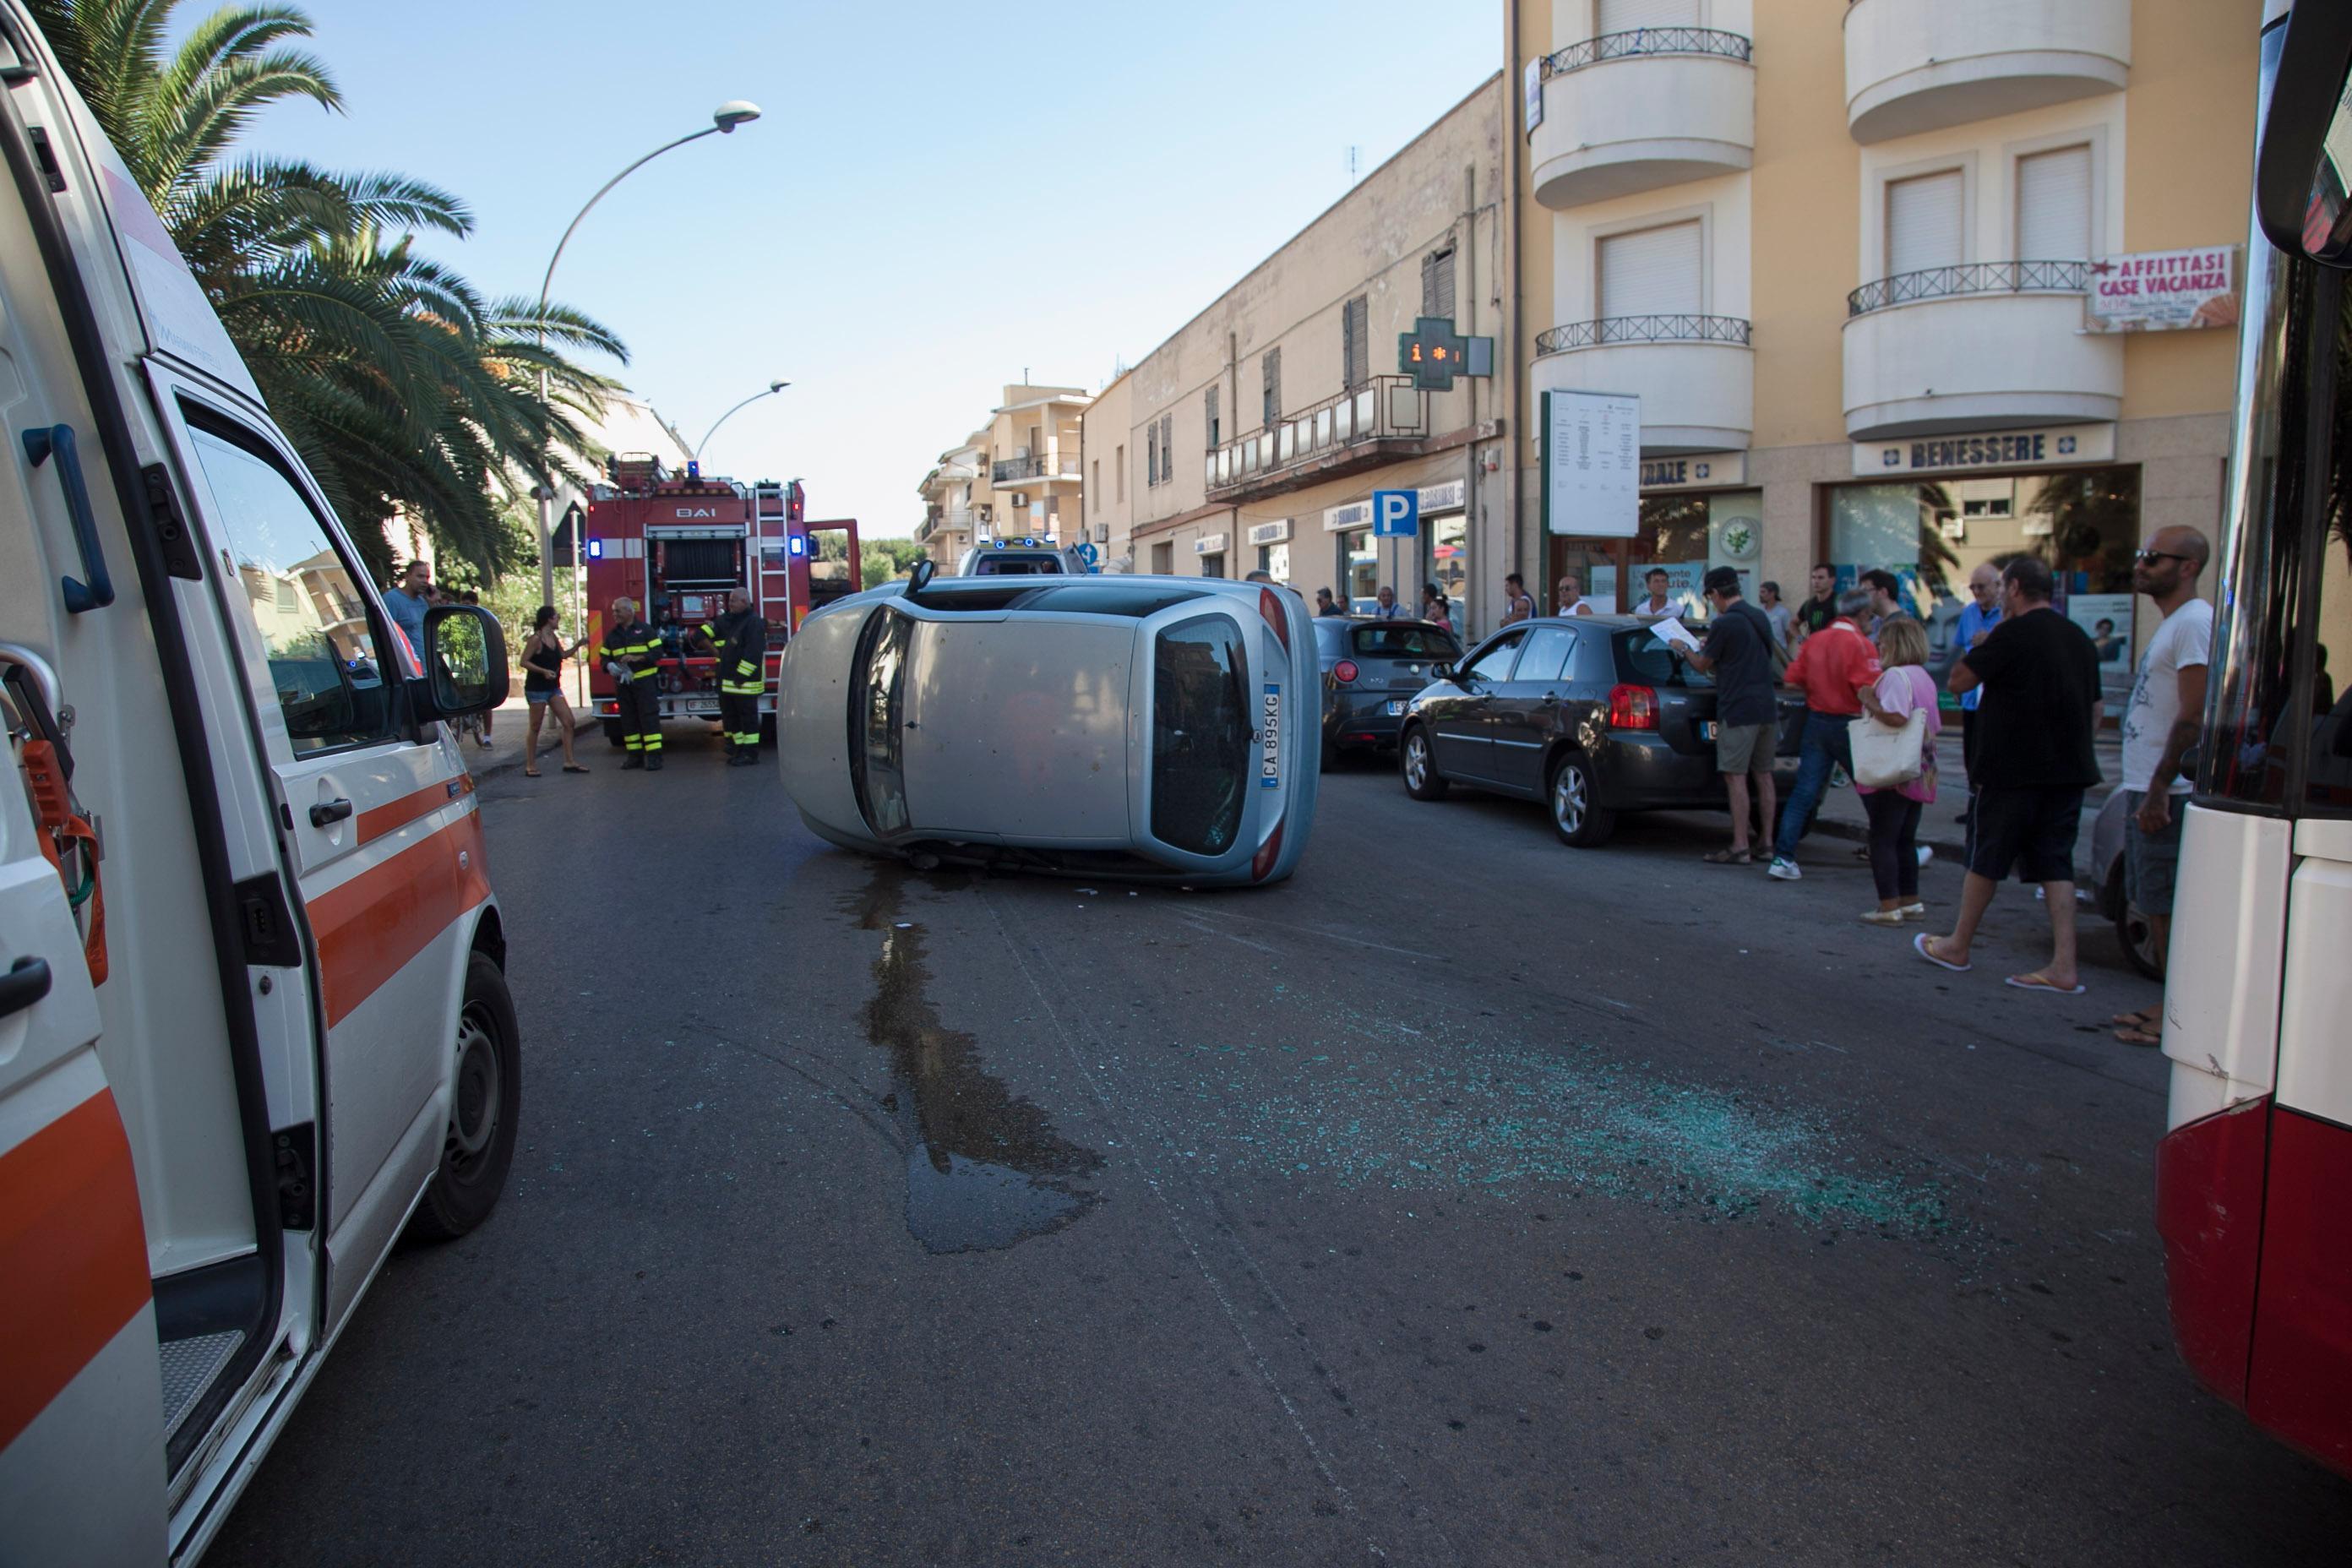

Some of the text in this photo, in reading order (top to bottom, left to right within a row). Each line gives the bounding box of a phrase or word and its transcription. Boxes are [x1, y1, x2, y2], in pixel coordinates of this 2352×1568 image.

[2121, 253, 2224, 277] AFFITTASI
[2099, 272, 2226, 296] CASE VACANZA
[1911, 433, 2045, 468] BENESSERE
[1640, 460, 1687, 486] RALE
[676, 508, 716, 517] BAI
[1382, 494, 1409, 531] P
[1264, 696, 1279, 776] CA 895KG
